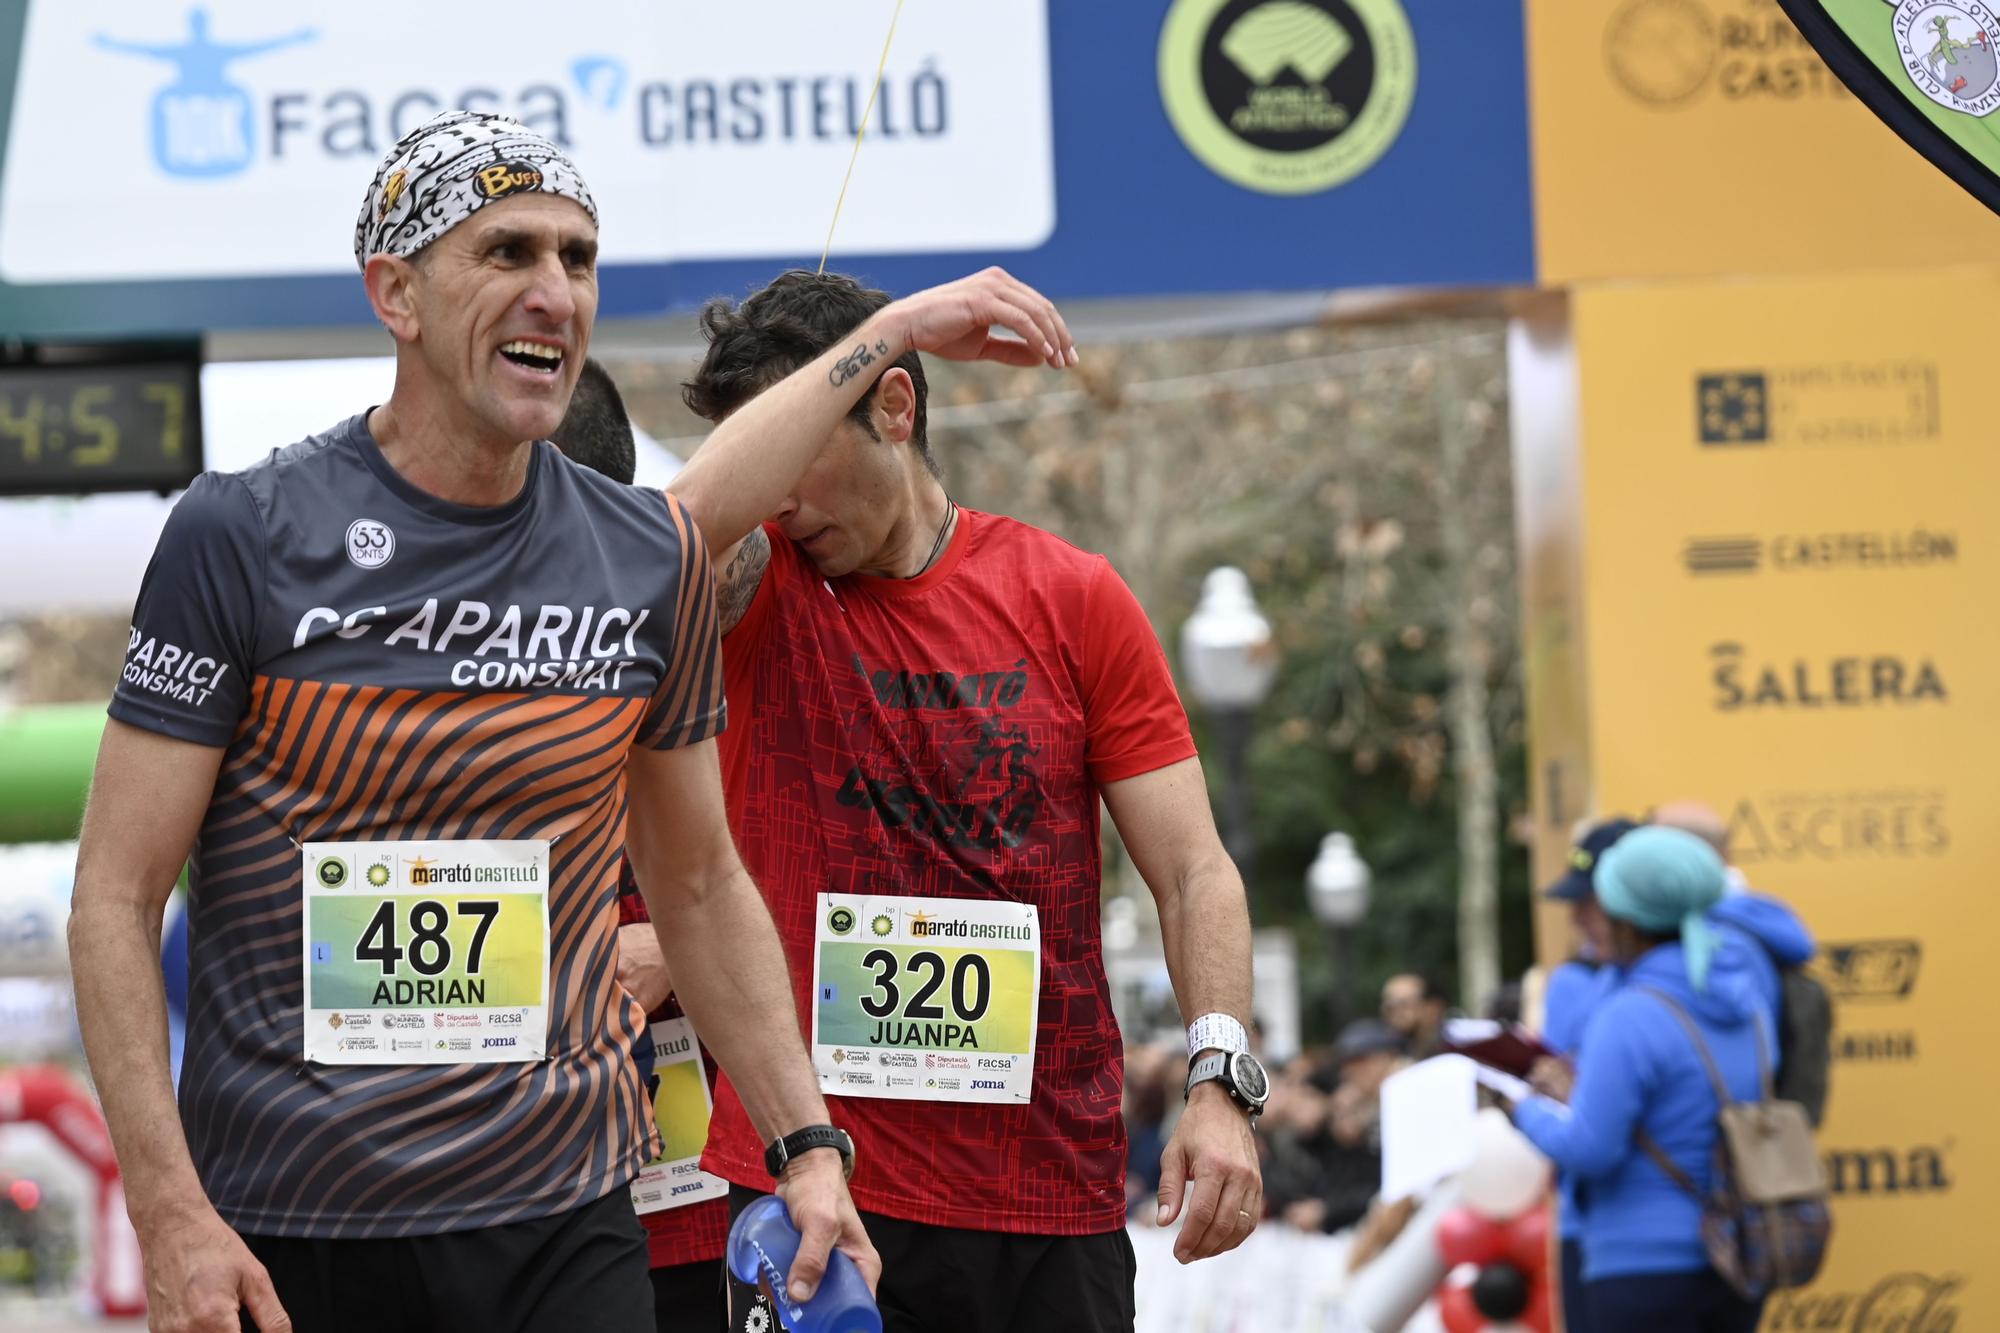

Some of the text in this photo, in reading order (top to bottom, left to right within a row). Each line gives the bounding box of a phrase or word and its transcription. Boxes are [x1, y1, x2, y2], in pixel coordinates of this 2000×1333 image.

[1908, 59, 1941, 95] CLUB
[639, 56, 948, 147] CASTELLÓ
[354, 527, 386, 549] 53
[383, 597, 650, 662] APARICI
[122, 661, 213, 706] CONSMAT
[450, 659, 636, 690] CONSMAT
[1710, 641, 1948, 713] SALERA
[381, 854, 392, 862] bp
[412, 863, 539, 883] marató CASTELLÓ
[886, 906, 895, 914] bp
[355, 900, 500, 976] 487
[912, 919, 1031, 940] marató CASTELLÓ
[317, 947, 324, 961] L
[372, 978, 486, 1006] ADRIAN
[824, 988, 831, 1000] M
[860, 949, 991, 1022] 320
[447, 1013, 478, 1021] Diputació
[655, 1035, 690, 1057] TELLÓ
[869, 1021, 979, 1049] JUANPA
[671, 1162, 699, 1175] Facs
[755, 1293, 767, 1304] bp
